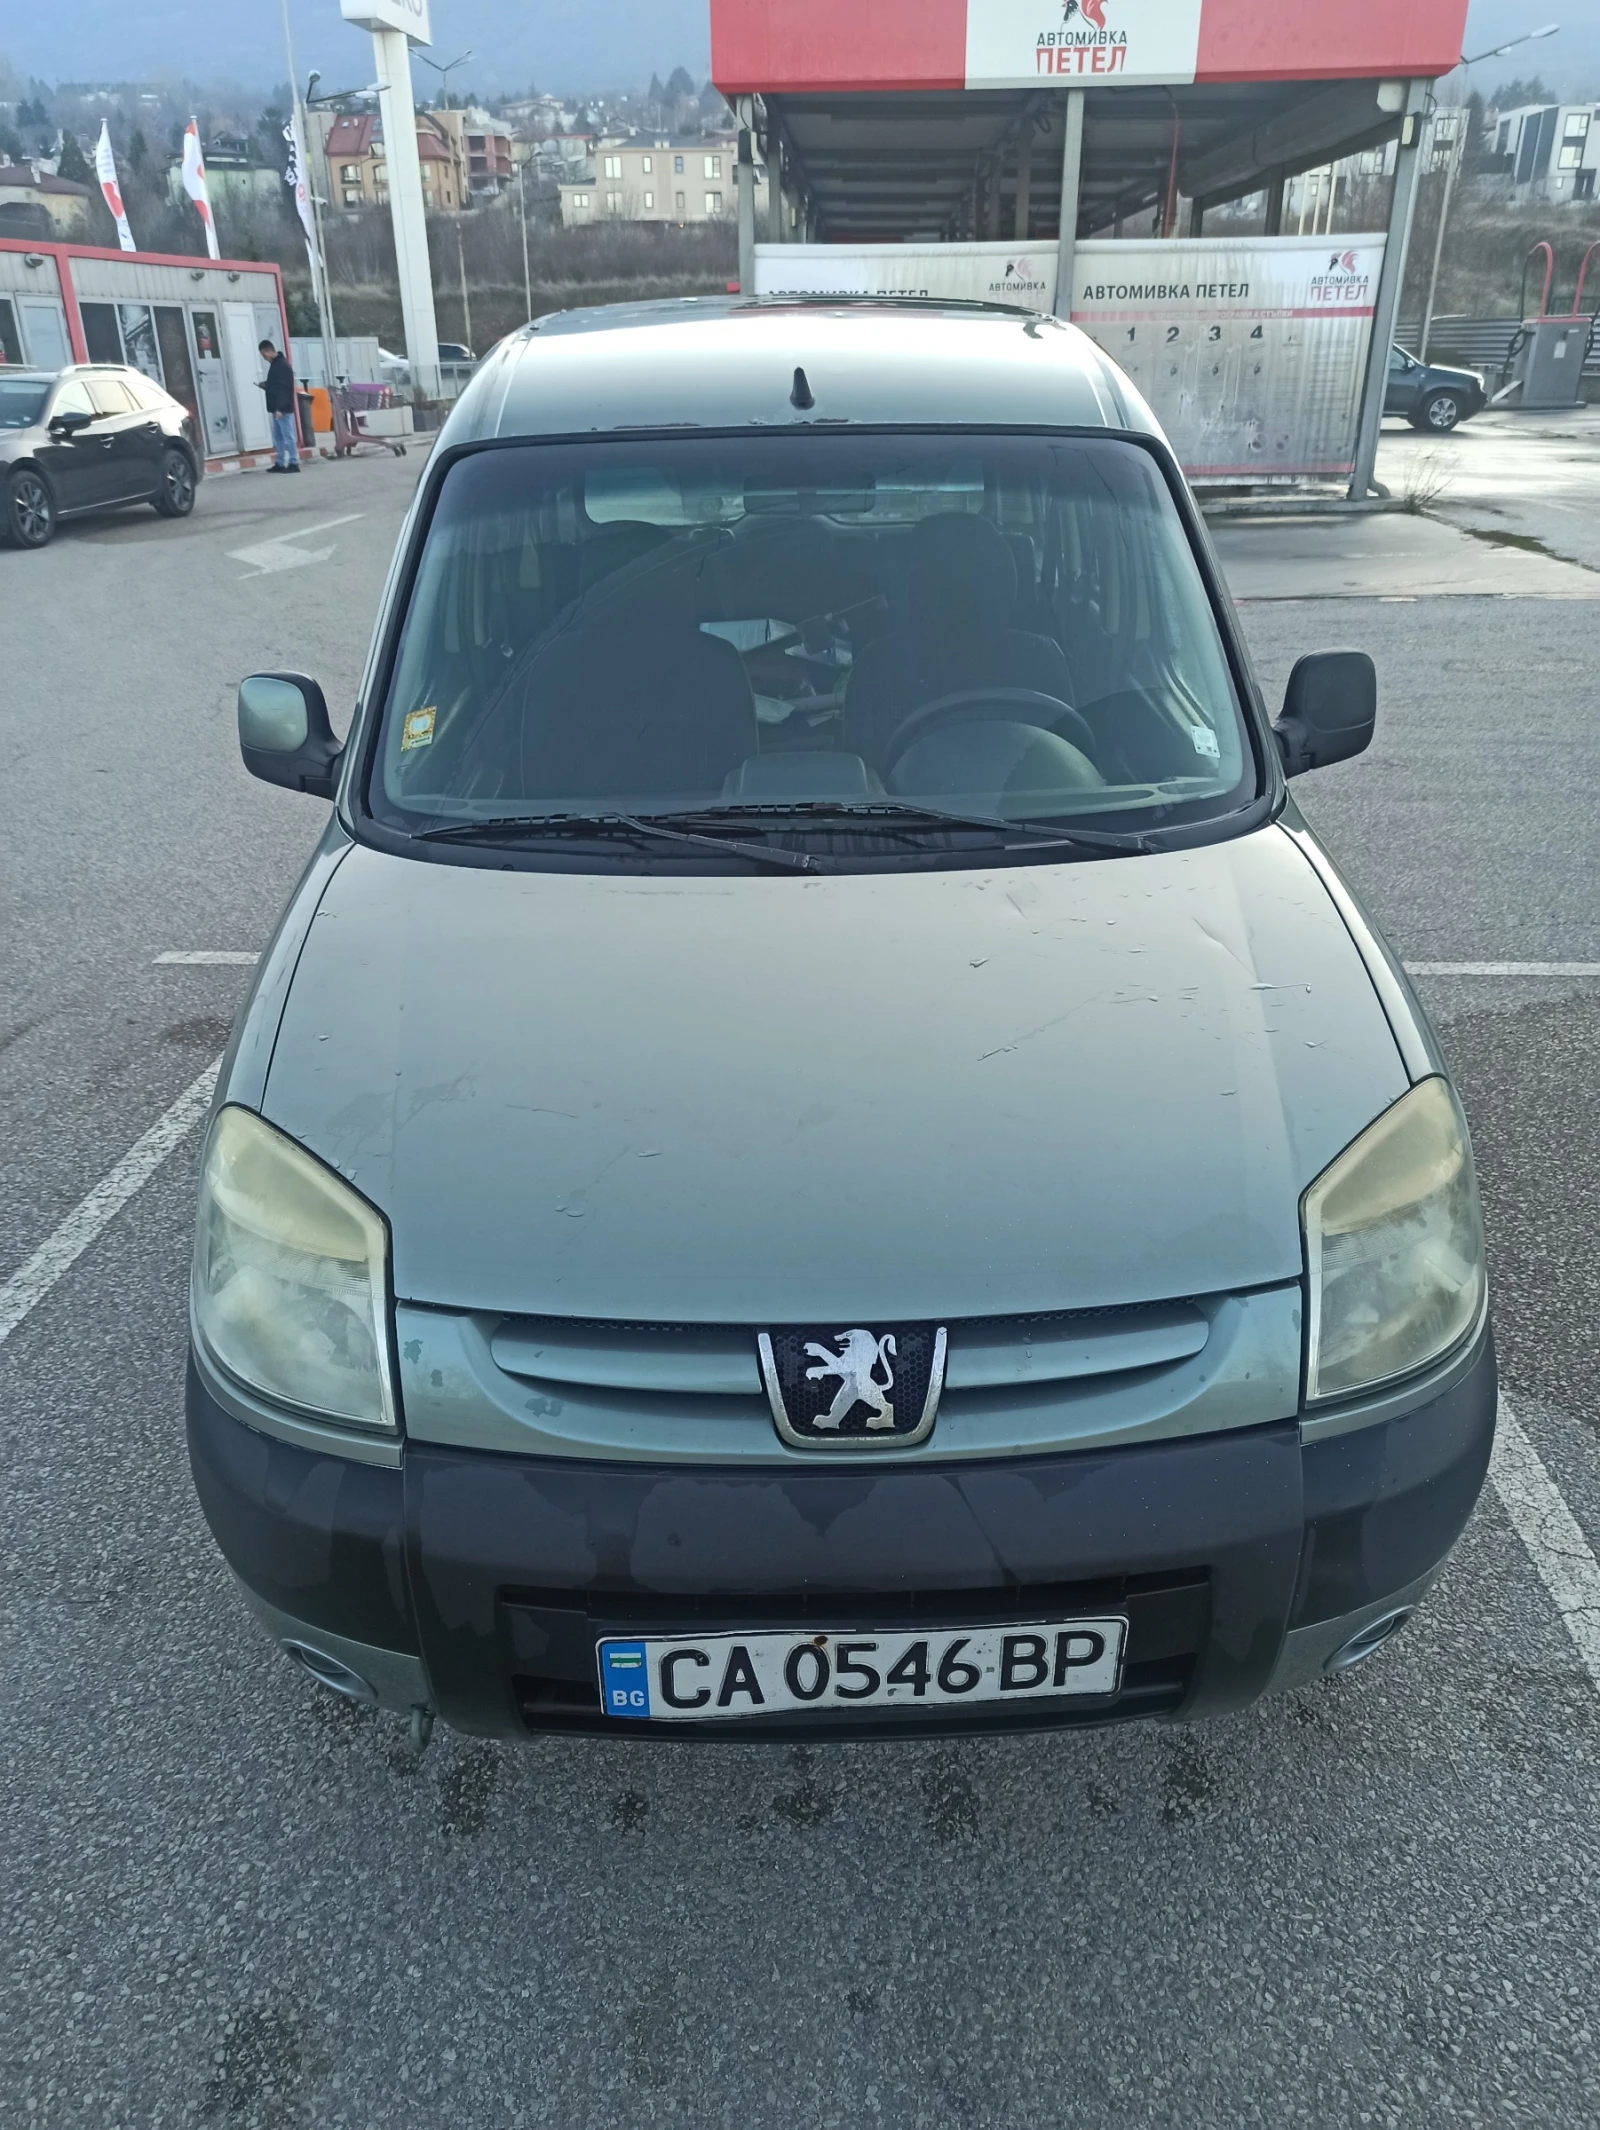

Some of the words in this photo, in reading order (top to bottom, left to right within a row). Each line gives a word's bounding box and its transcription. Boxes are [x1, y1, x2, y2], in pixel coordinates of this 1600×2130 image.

[1036, 30, 1128, 46] АВТОМИВКА
[1036, 46, 1128, 74] ПЕТЕЛ
[988, 281, 1046, 292] АВТОМИВКА
[1310, 275, 1369, 285] АВТОМИВКА
[1083, 284, 1191, 300] АВТОМИВКА
[1195, 283, 1250, 298] ПЕТЕЛ
[1310, 284, 1368, 301] ПЕТЕЛ
[1127, 327, 1136, 341] 1
[1166, 326, 1180, 342] 2
[1208, 325, 1222, 341] 3
[1250, 325, 1263, 339] 4
[658, 1646, 766, 1709] CA
[783, 1638, 983, 1700] 0546
[998, 1631, 1106, 1692] BP
[612, 1689, 646, 1707] BG
